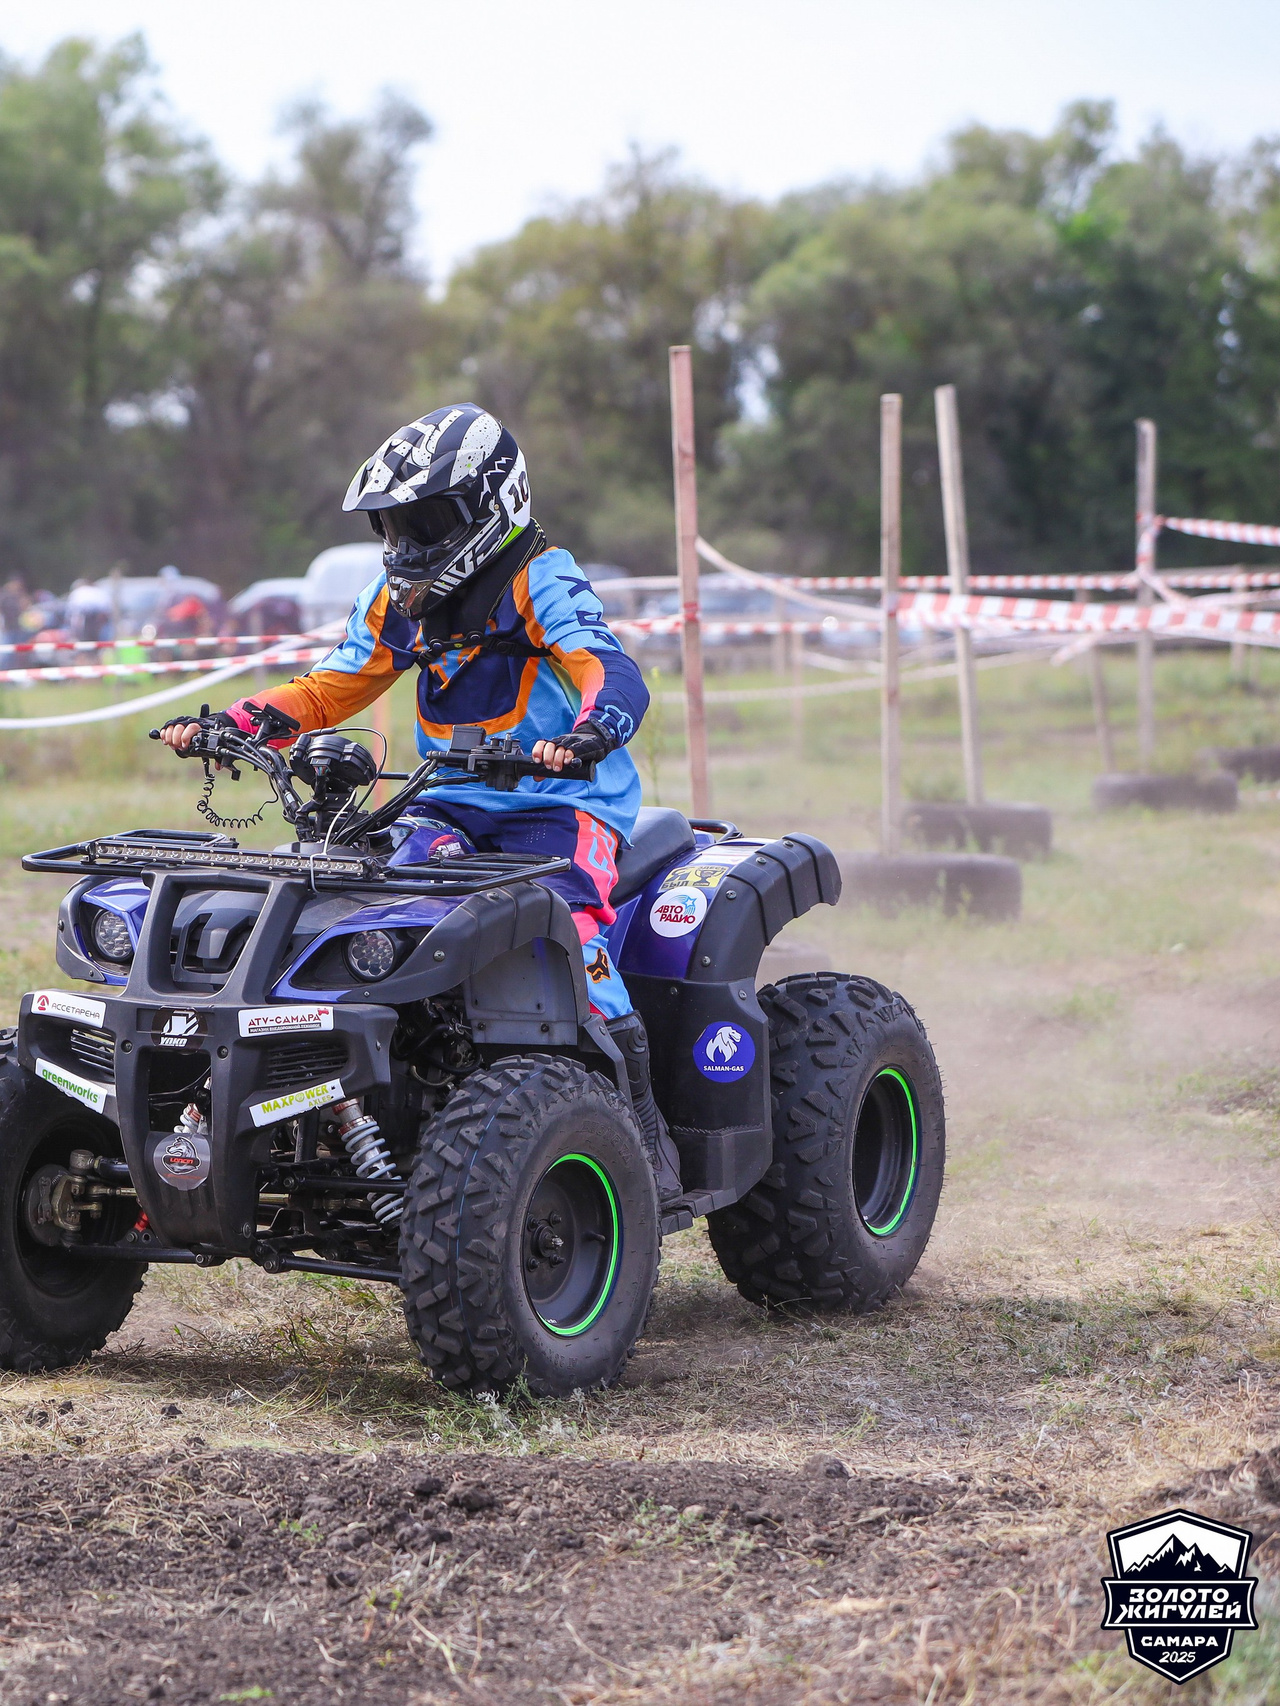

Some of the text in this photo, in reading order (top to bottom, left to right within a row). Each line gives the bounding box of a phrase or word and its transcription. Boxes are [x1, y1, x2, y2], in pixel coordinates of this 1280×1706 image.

[508, 471, 529, 514] 10
[655, 905, 683, 914] АВТО
[659, 914, 696, 924] РАДИО
[52, 1003, 100, 1019] АССЕТАРЕНА
[159, 1037, 187, 1047] YOKO
[42, 1069, 99, 1103] greenworks
[261, 1085, 329, 1114] MAXPOWER
[308, 1094, 332, 1107] AXLES
